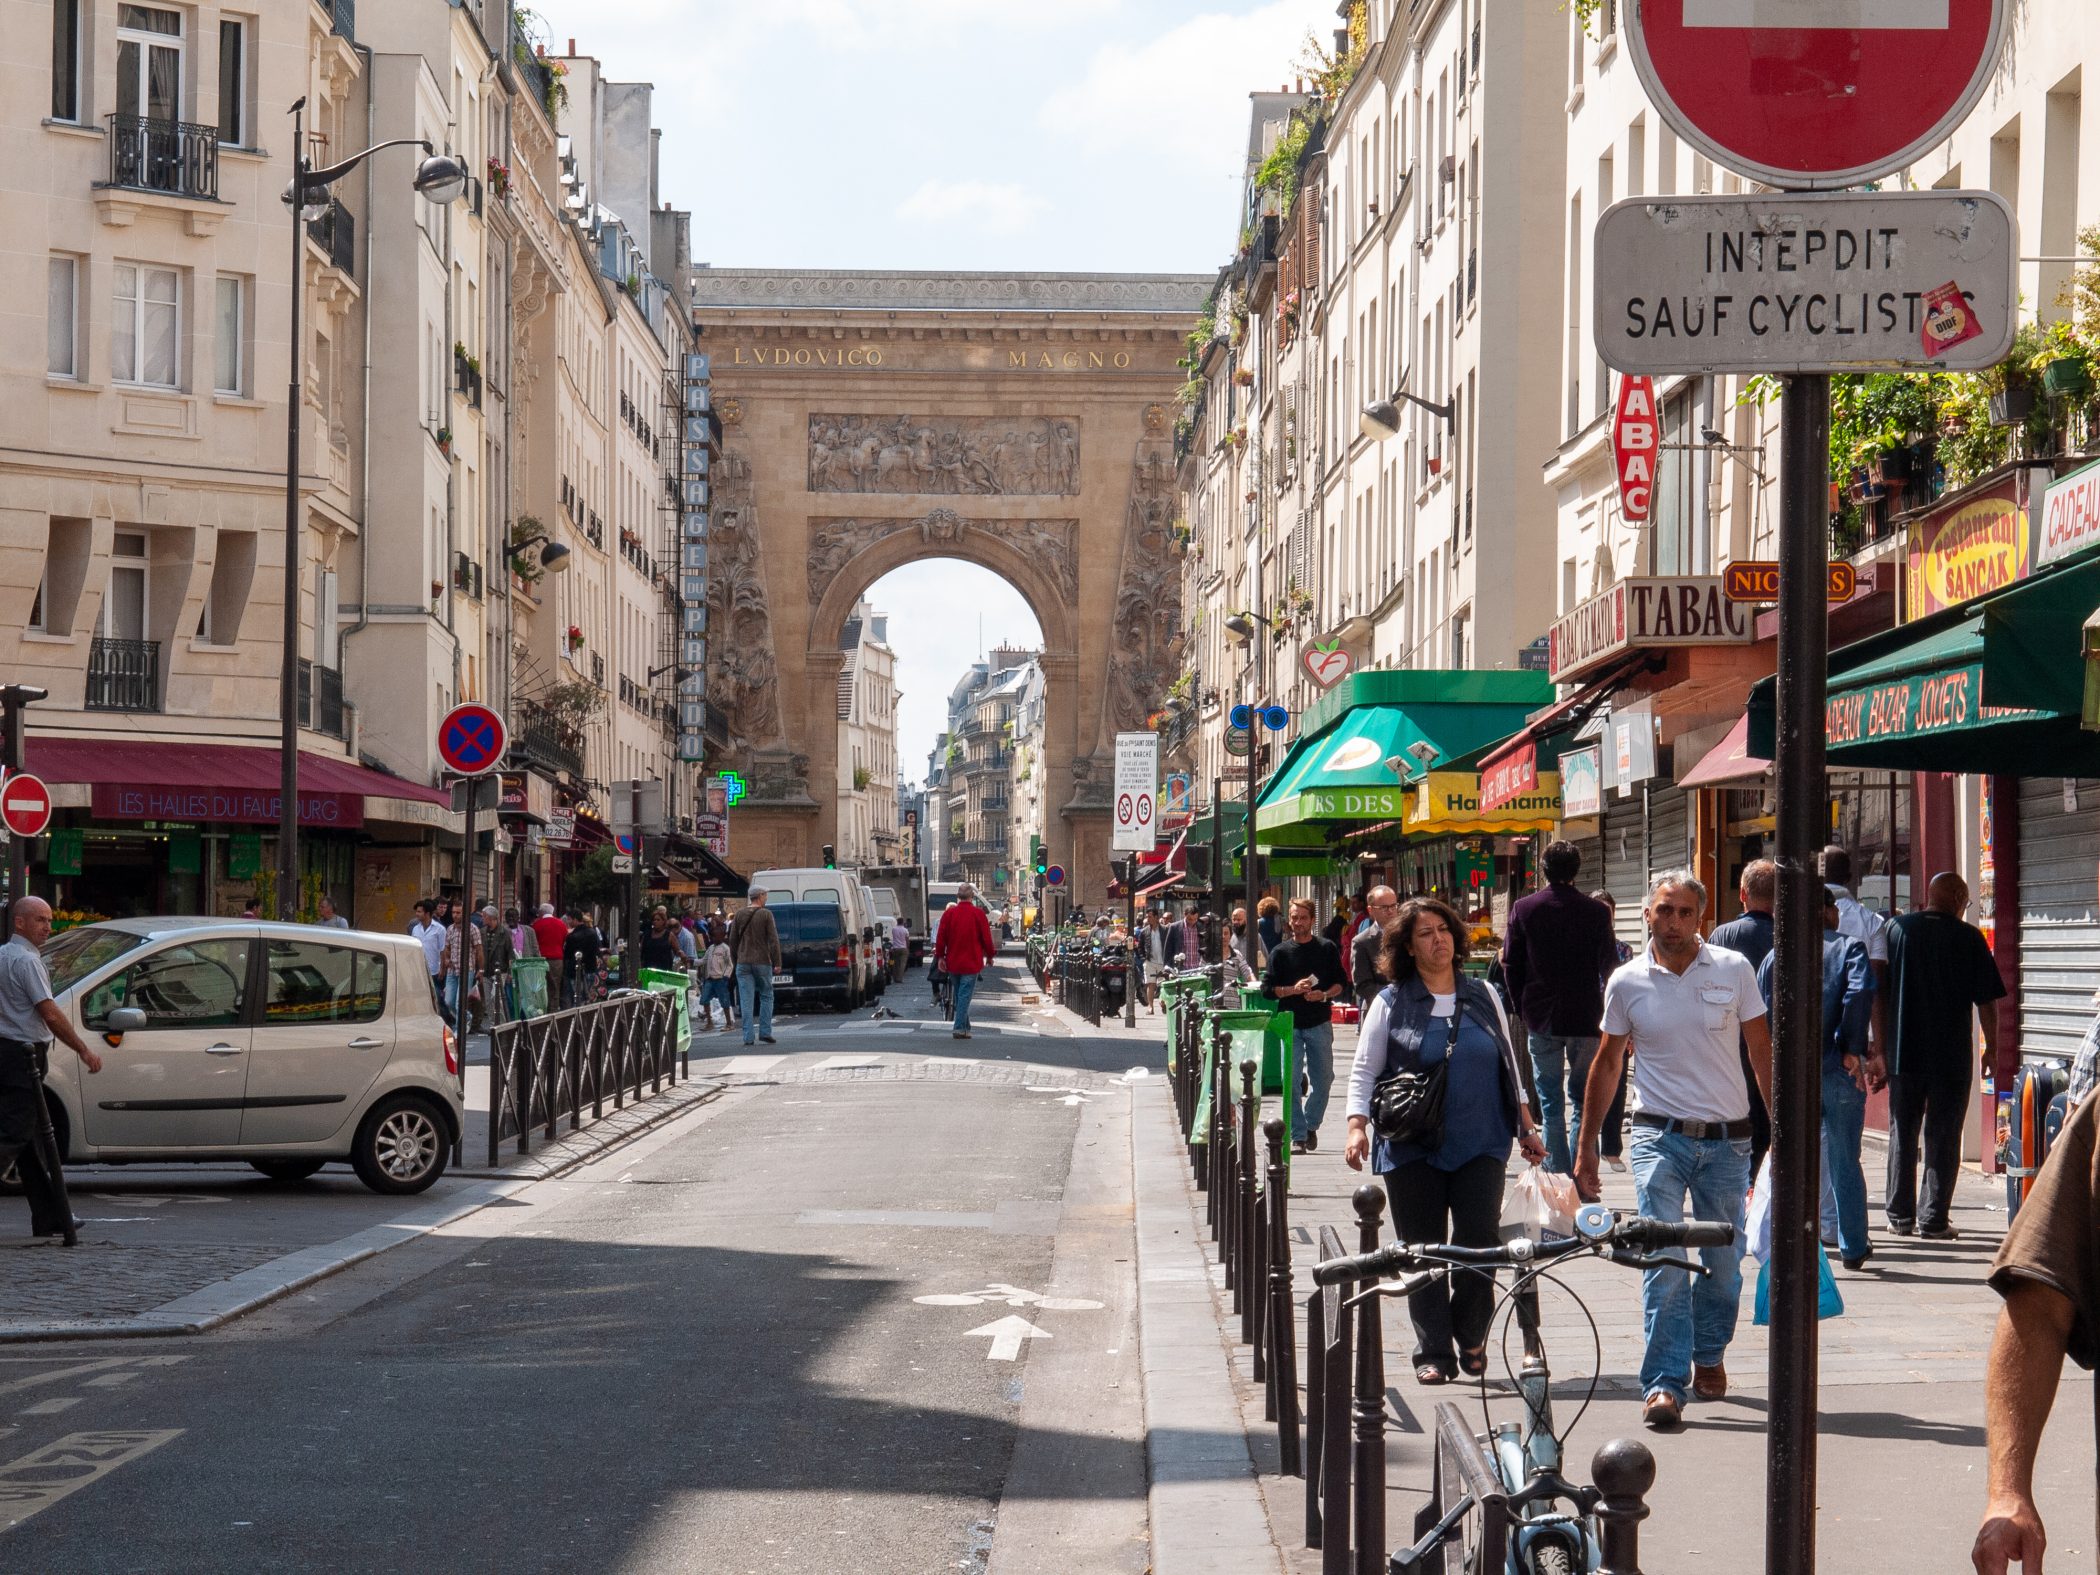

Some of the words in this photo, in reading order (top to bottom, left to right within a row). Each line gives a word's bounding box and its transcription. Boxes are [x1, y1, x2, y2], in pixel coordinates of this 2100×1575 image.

[1626, 296, 1733, 338] SAUF
[1749, 290, 1976, 336] CYCLIST
[734, 347, 883, 366] LVDOVICO
[1008, 351, 1130, 368] MAGNO
[1621, 375, 1653, 514] ABAC
[1734, 571, 1846, 592] NICS
[1945, 550, 2009, 600] SANCAK
[1631, 585, 1745, 638] TABAC
[1559, 610, 1580, 671] TABAC
[1581, 606, 1590, 659] LE
[1826, 694, 1866, 743] ADEAUX
[1868, 684, 1910, 736] BAZAR
[1915, 671, 1968, 730] JOUETS
[118, 792, 145, 815] LES
[150, 794, 208, 817] HALLES
[213, 796, 238, 817] DU
[244, 797, 338, 821] FAUBURG
[406, 804, 438, 821] FRUITS
[1140, 802, 1148, 816] 15
[1345, 795, 1393, 813] DES
